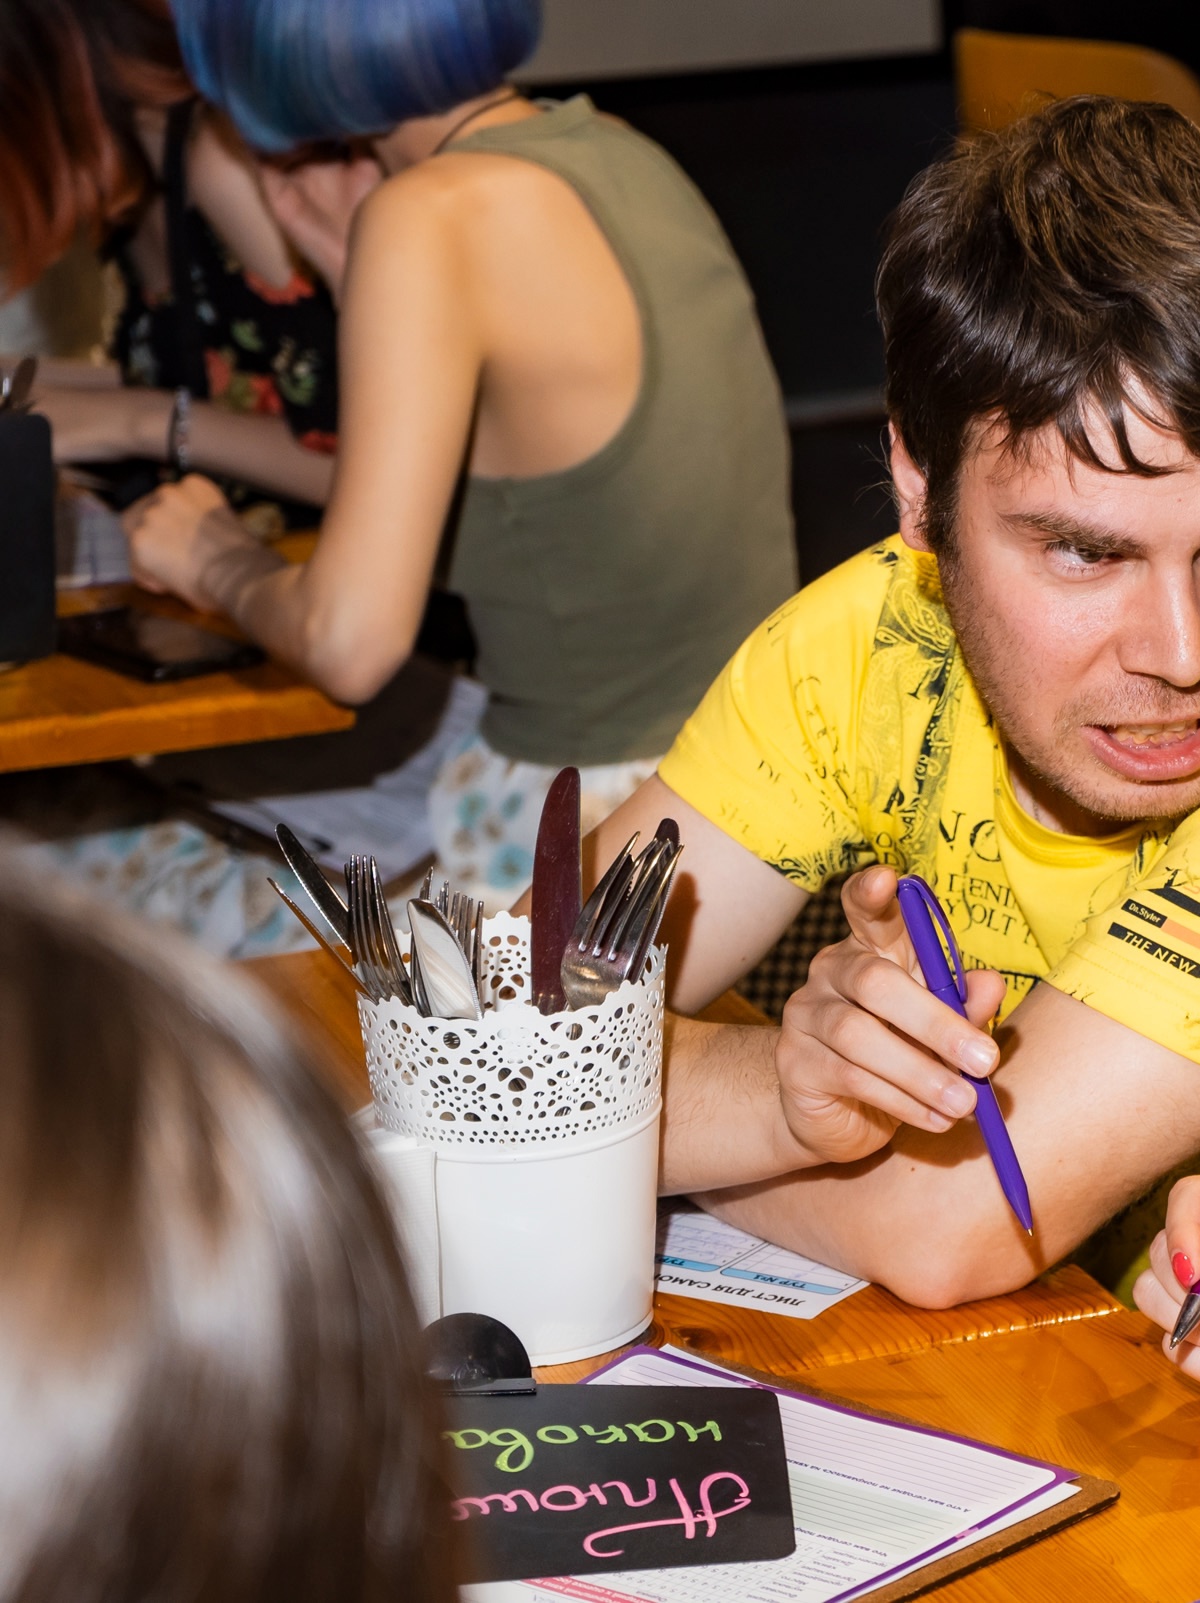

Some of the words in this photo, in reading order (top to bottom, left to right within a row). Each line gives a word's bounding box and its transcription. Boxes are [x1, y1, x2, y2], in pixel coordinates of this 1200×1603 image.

[1123, 931, 1152, 952] THE
[1152, 949, 1197, 975] NEW
[712, 1284, 755, 1297] ДЛЯ
[752, 1289, 807, 1307] ЛИСТ
[441, 1419, 723, 1473] накова
[891, 1488, 927, 1500] сегодня
[928, 1498, 945, 1506] вам
